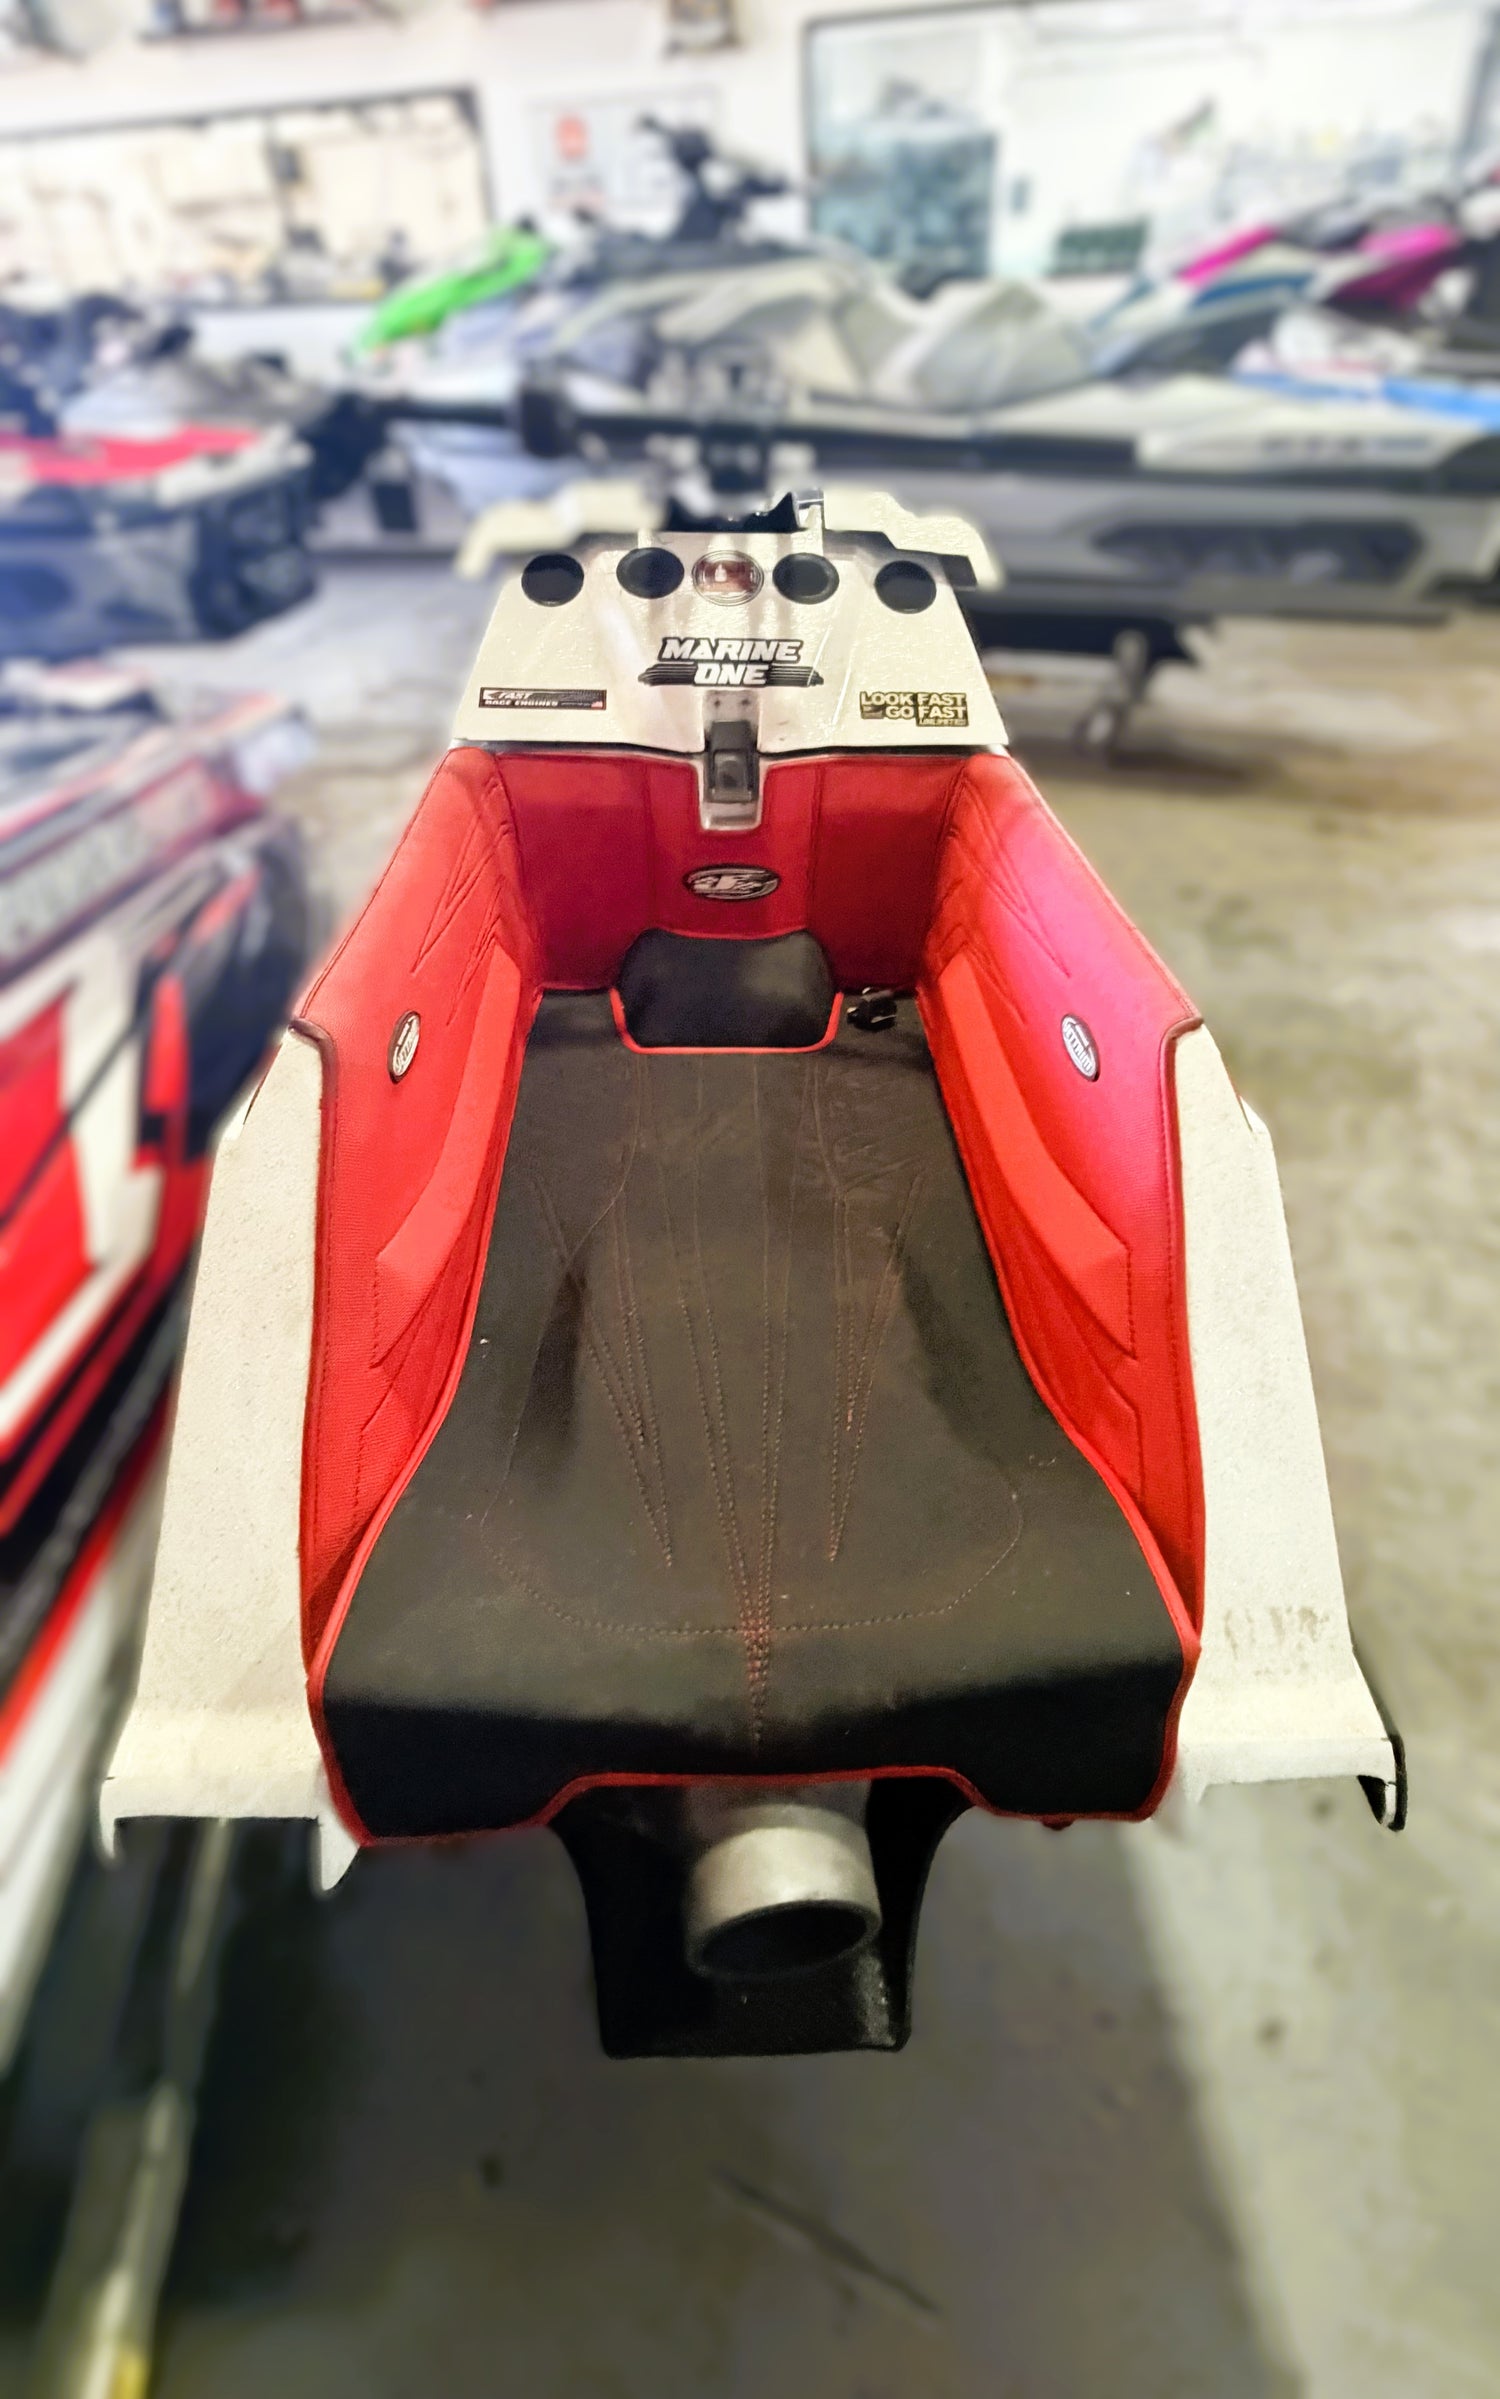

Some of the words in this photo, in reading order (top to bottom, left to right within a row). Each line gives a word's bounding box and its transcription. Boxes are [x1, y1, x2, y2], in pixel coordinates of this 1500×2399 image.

[660, 637, 802, 662] MARINE
[694, 662, 769, 685] ONE
[861, 692, 914, 706] LOOK
[917, 693, 966, 706] FAST
[885, 706, 915, 720] GO
[918, 706, 967, 719] FAST
